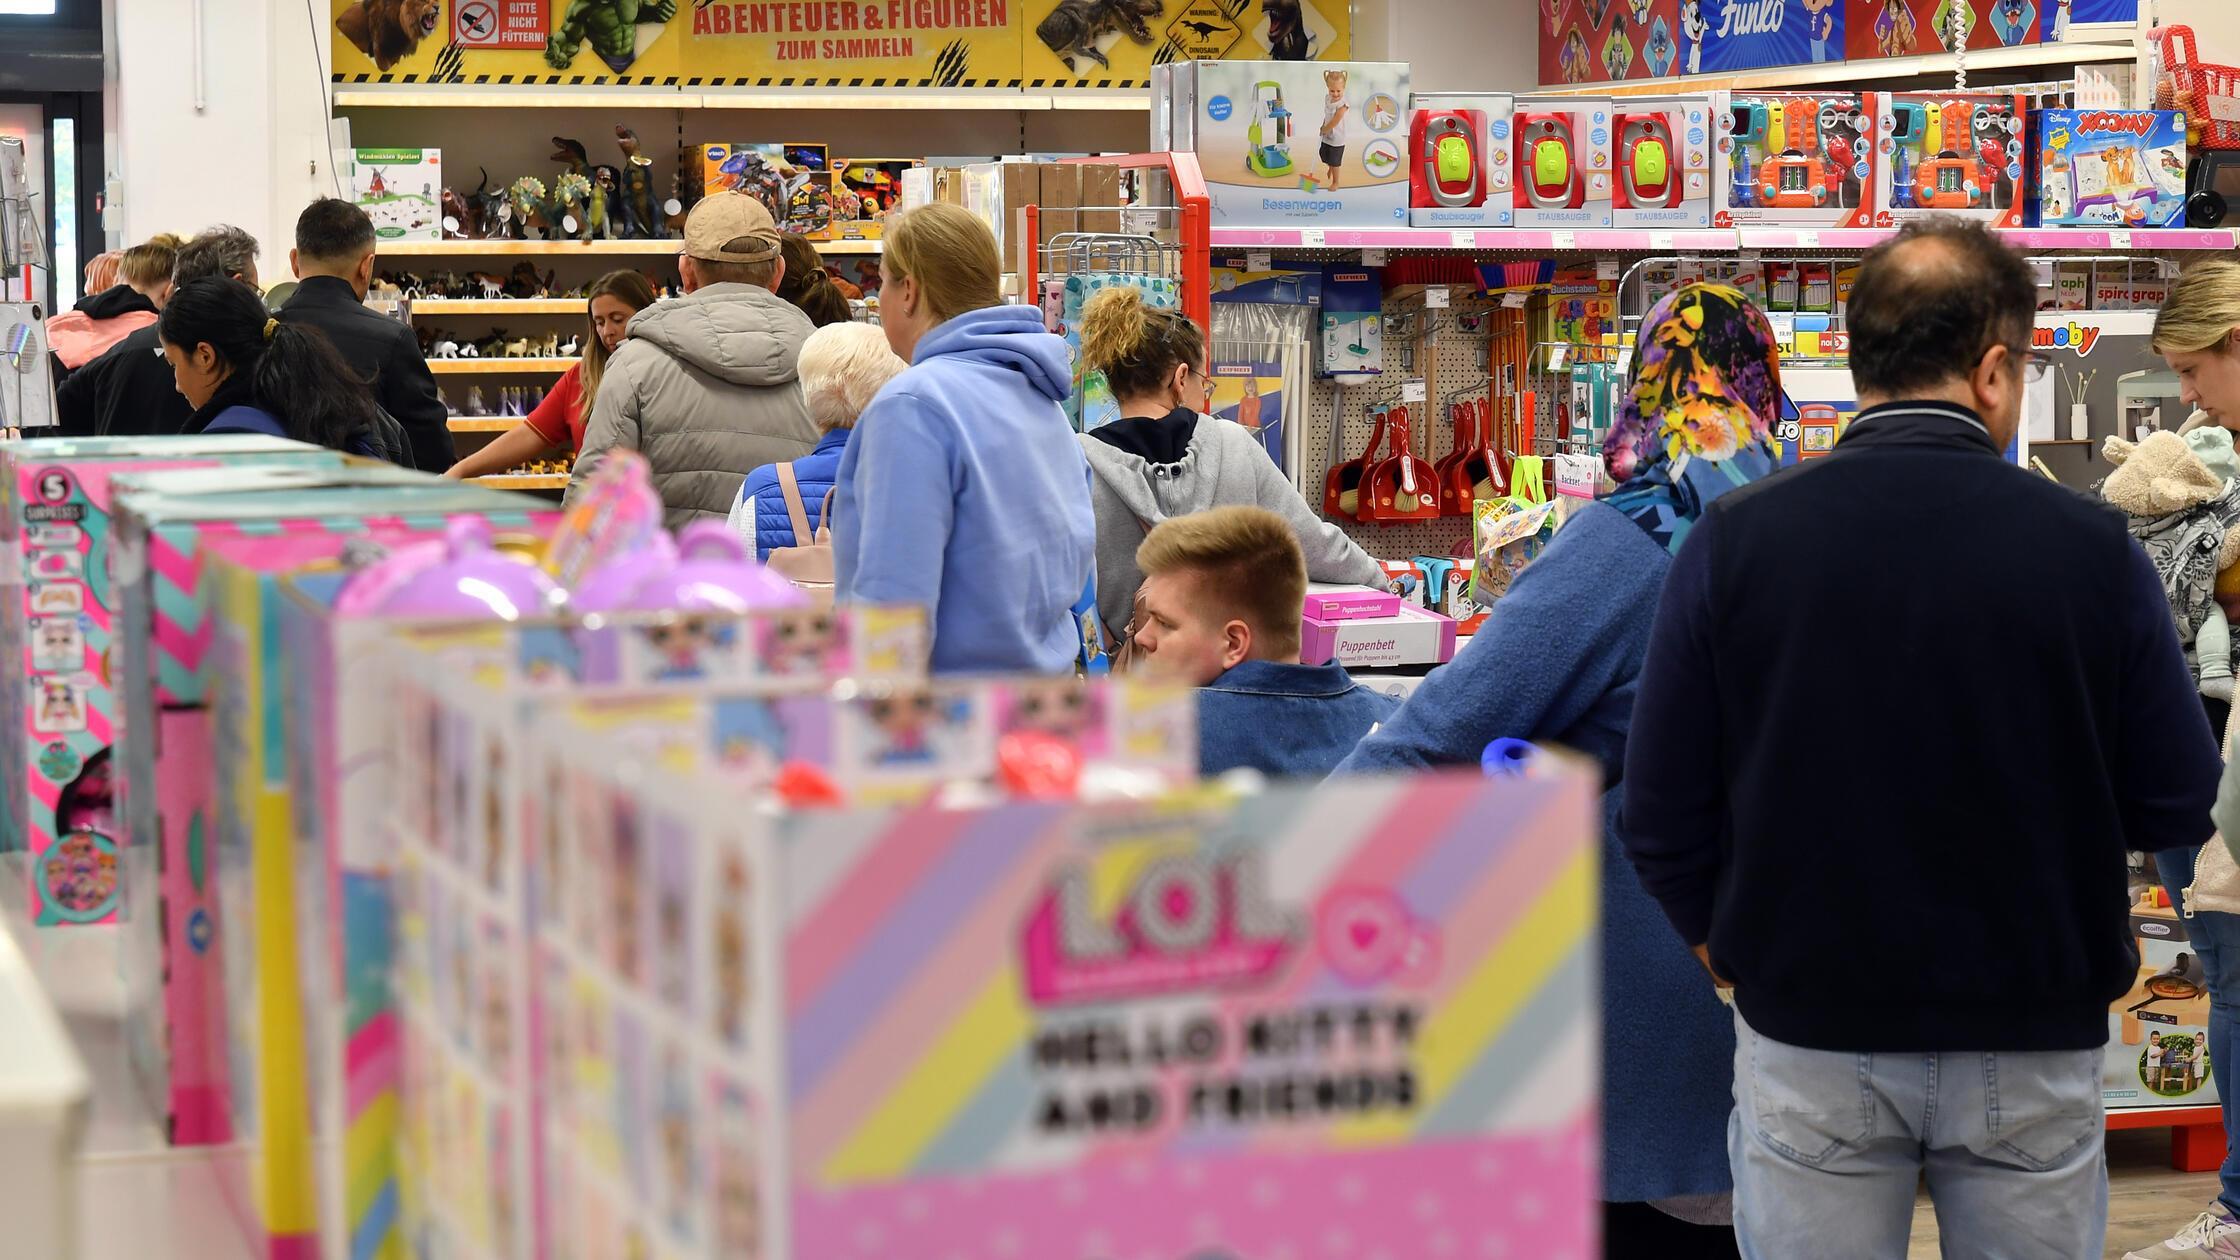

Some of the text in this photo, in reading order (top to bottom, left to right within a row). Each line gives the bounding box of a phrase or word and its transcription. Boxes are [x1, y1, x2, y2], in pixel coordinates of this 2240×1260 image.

[509, 3, 536, 13] BITTE
[509, 17, 538, 28] NICHT
[692, 0, 1007, 35] ABENTEUER & FIGUREN
[502, 30, 544, 42] FÜTTERN!
[777, 37, 913, 60] ZUM SAMMELN
[2076, 111, 2156, 137] XOOMY
[1263, 199, 1342, 211] Besenwagen
[1537, 212, 1591, 220] STAUBSAUGER
[1635, 212, 1688, 220] STAUBSAUGER
[1551, 285, 1598, 294] Buchstaben
[2097, 284, 2172, 303] spirograp
[1820, 339, 1839, 347] nors
[2032, 322, 2100, 353] moby
[1561, 474, 1581, 487] Backset
[1340, 639, 1395, 654] Puppenbett
[2142, 925, 2169, 934] écoiffier
[1034, 1004, 1422, 1070] HELLO KITTY
[1037, 1068, 1418, 1134] AND FRIENDS
